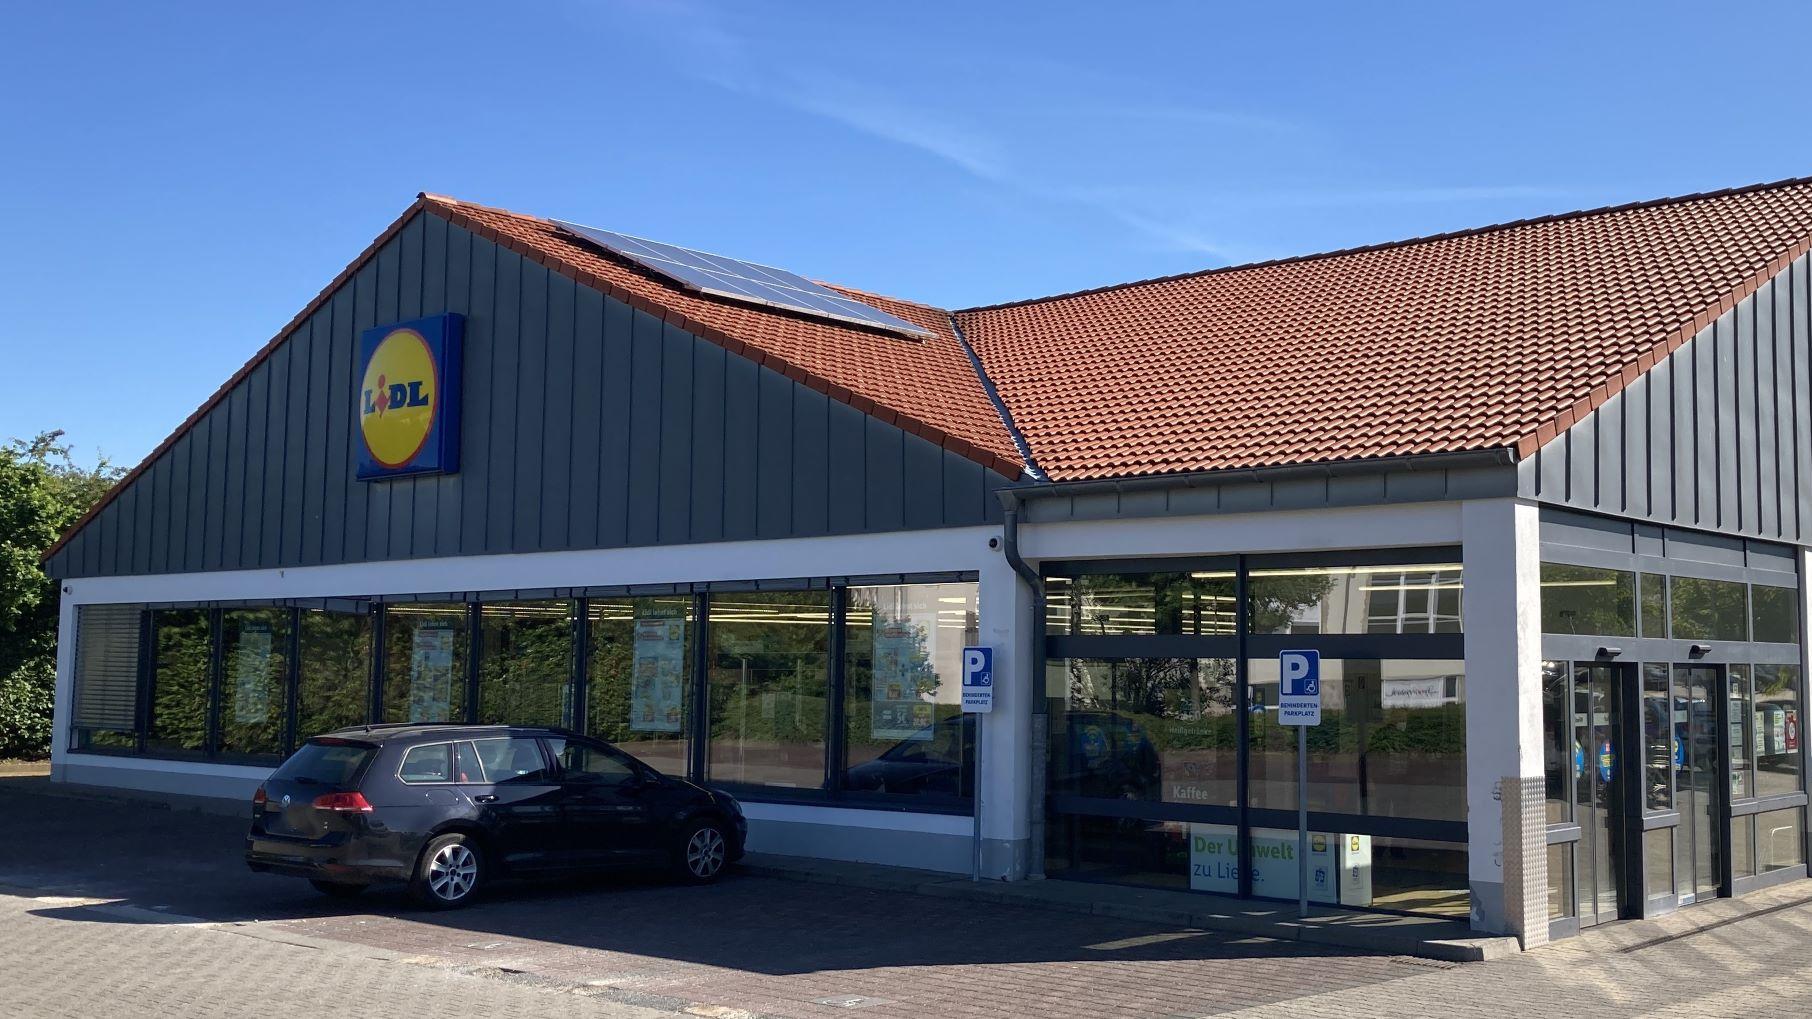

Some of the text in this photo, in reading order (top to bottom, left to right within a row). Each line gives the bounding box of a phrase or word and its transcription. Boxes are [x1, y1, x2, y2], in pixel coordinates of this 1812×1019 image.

[964, 650, 985, 684] P
[1283, 655, 1309, 693] P
[1172, 785, 1208, 800] Kaffee
[1194, 836, 1223, 854] Der
[1193, 860, 1265, 882] zu Liee.
